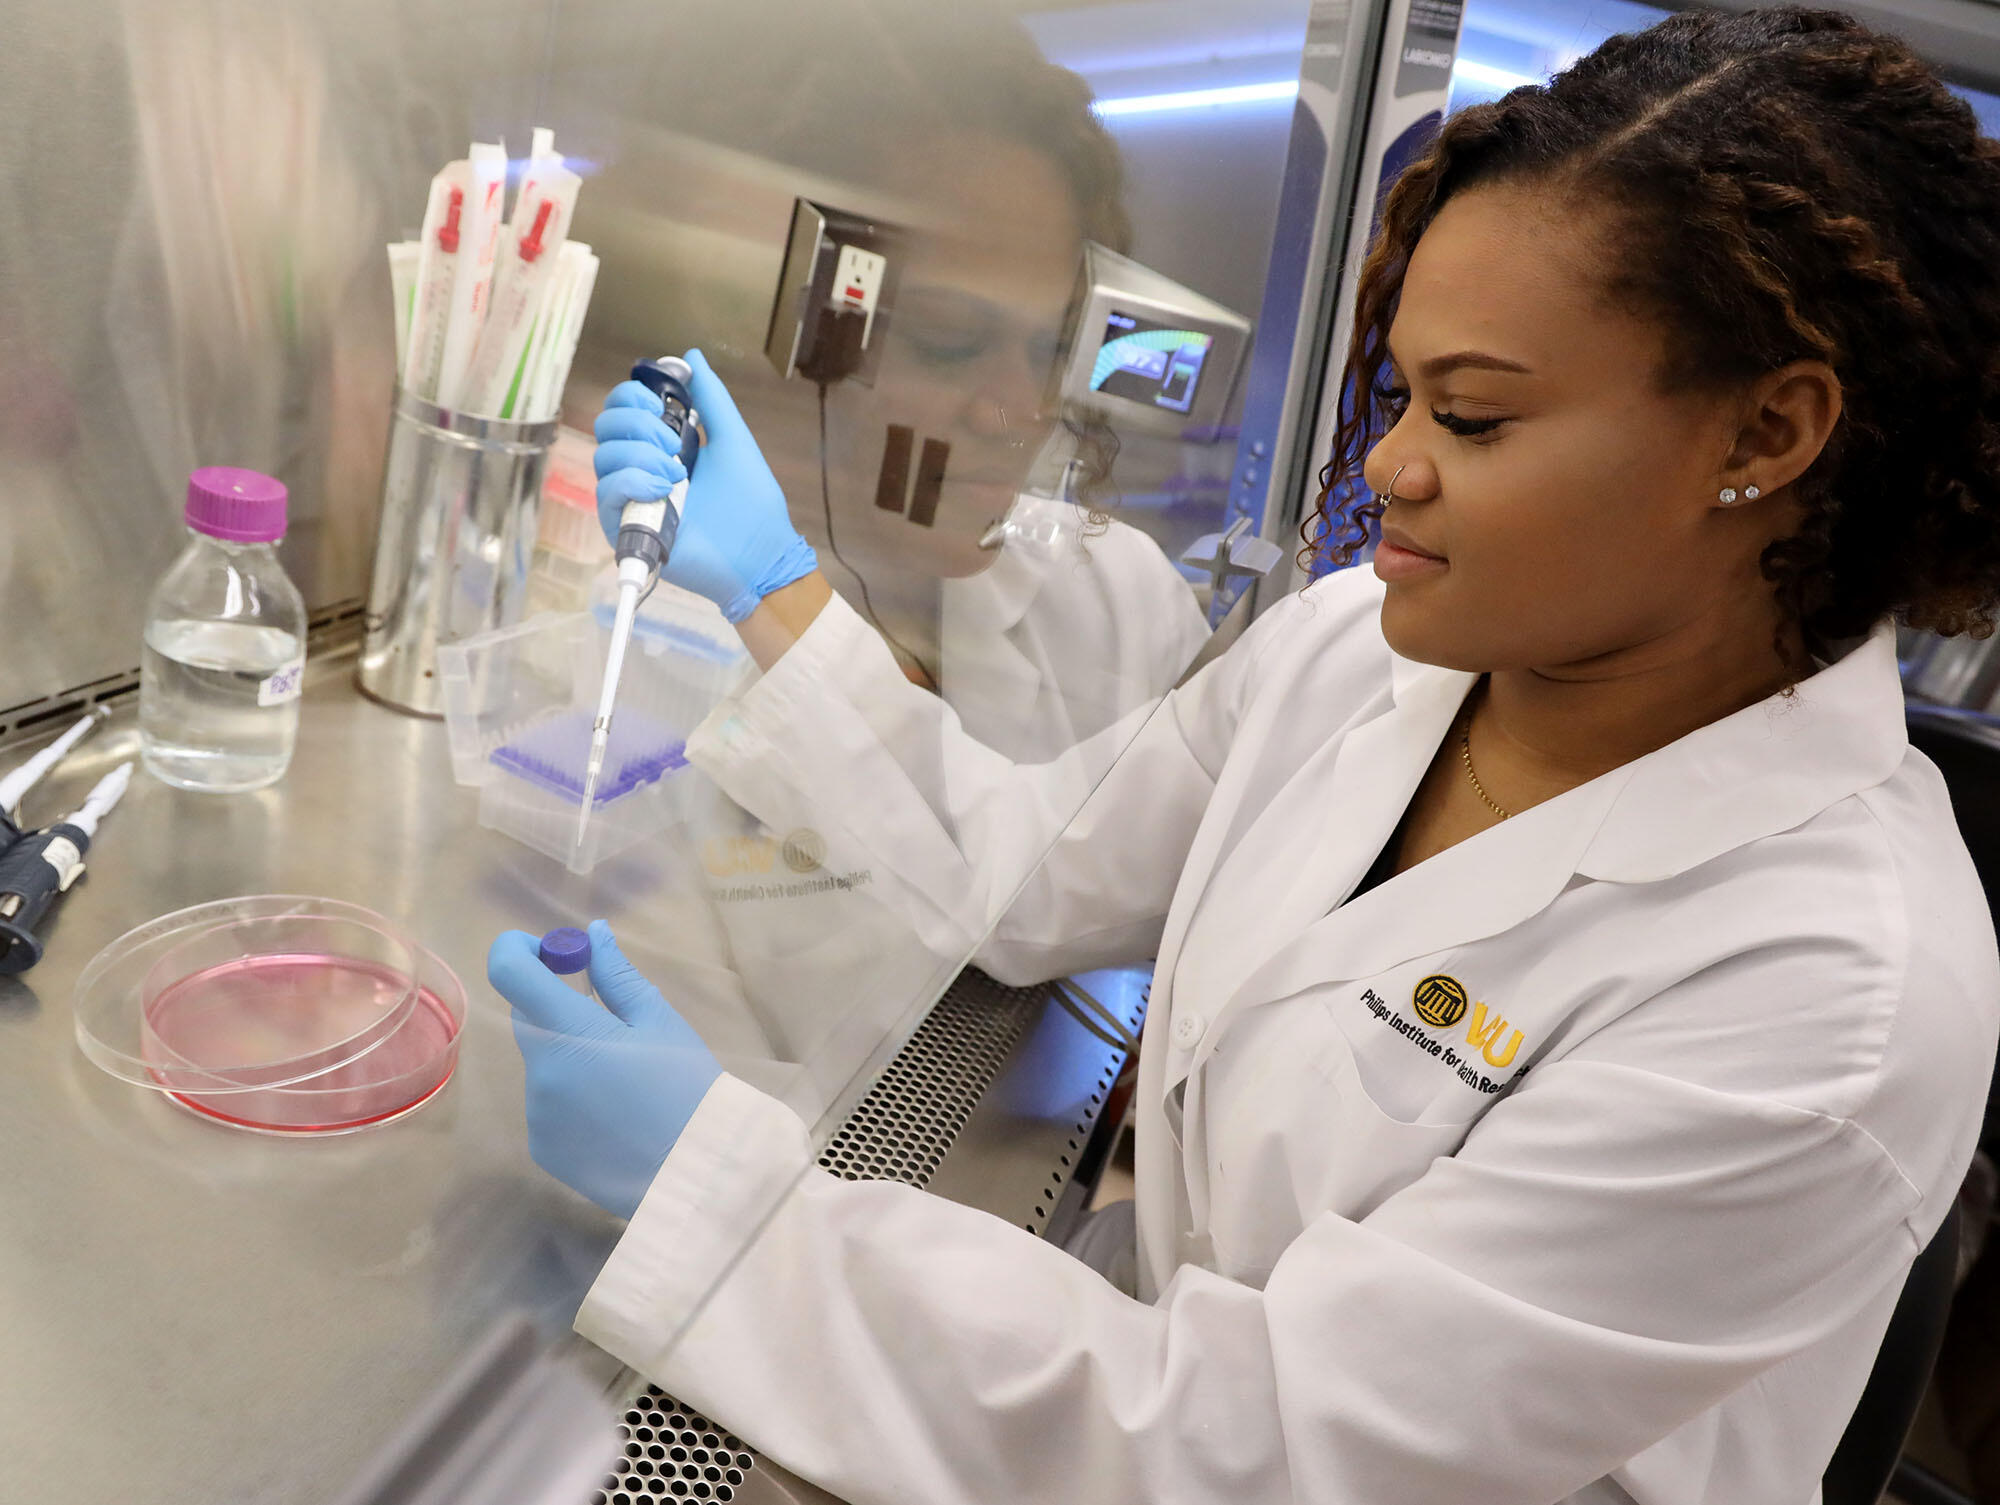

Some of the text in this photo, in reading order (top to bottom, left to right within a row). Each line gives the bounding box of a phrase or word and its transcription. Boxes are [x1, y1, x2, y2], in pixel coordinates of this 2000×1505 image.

[1360, 988, 1391, 1021] Philips
[1389, 1012, 1442, 1057] Institute
[1441, 1047, 1462, 1069] for
